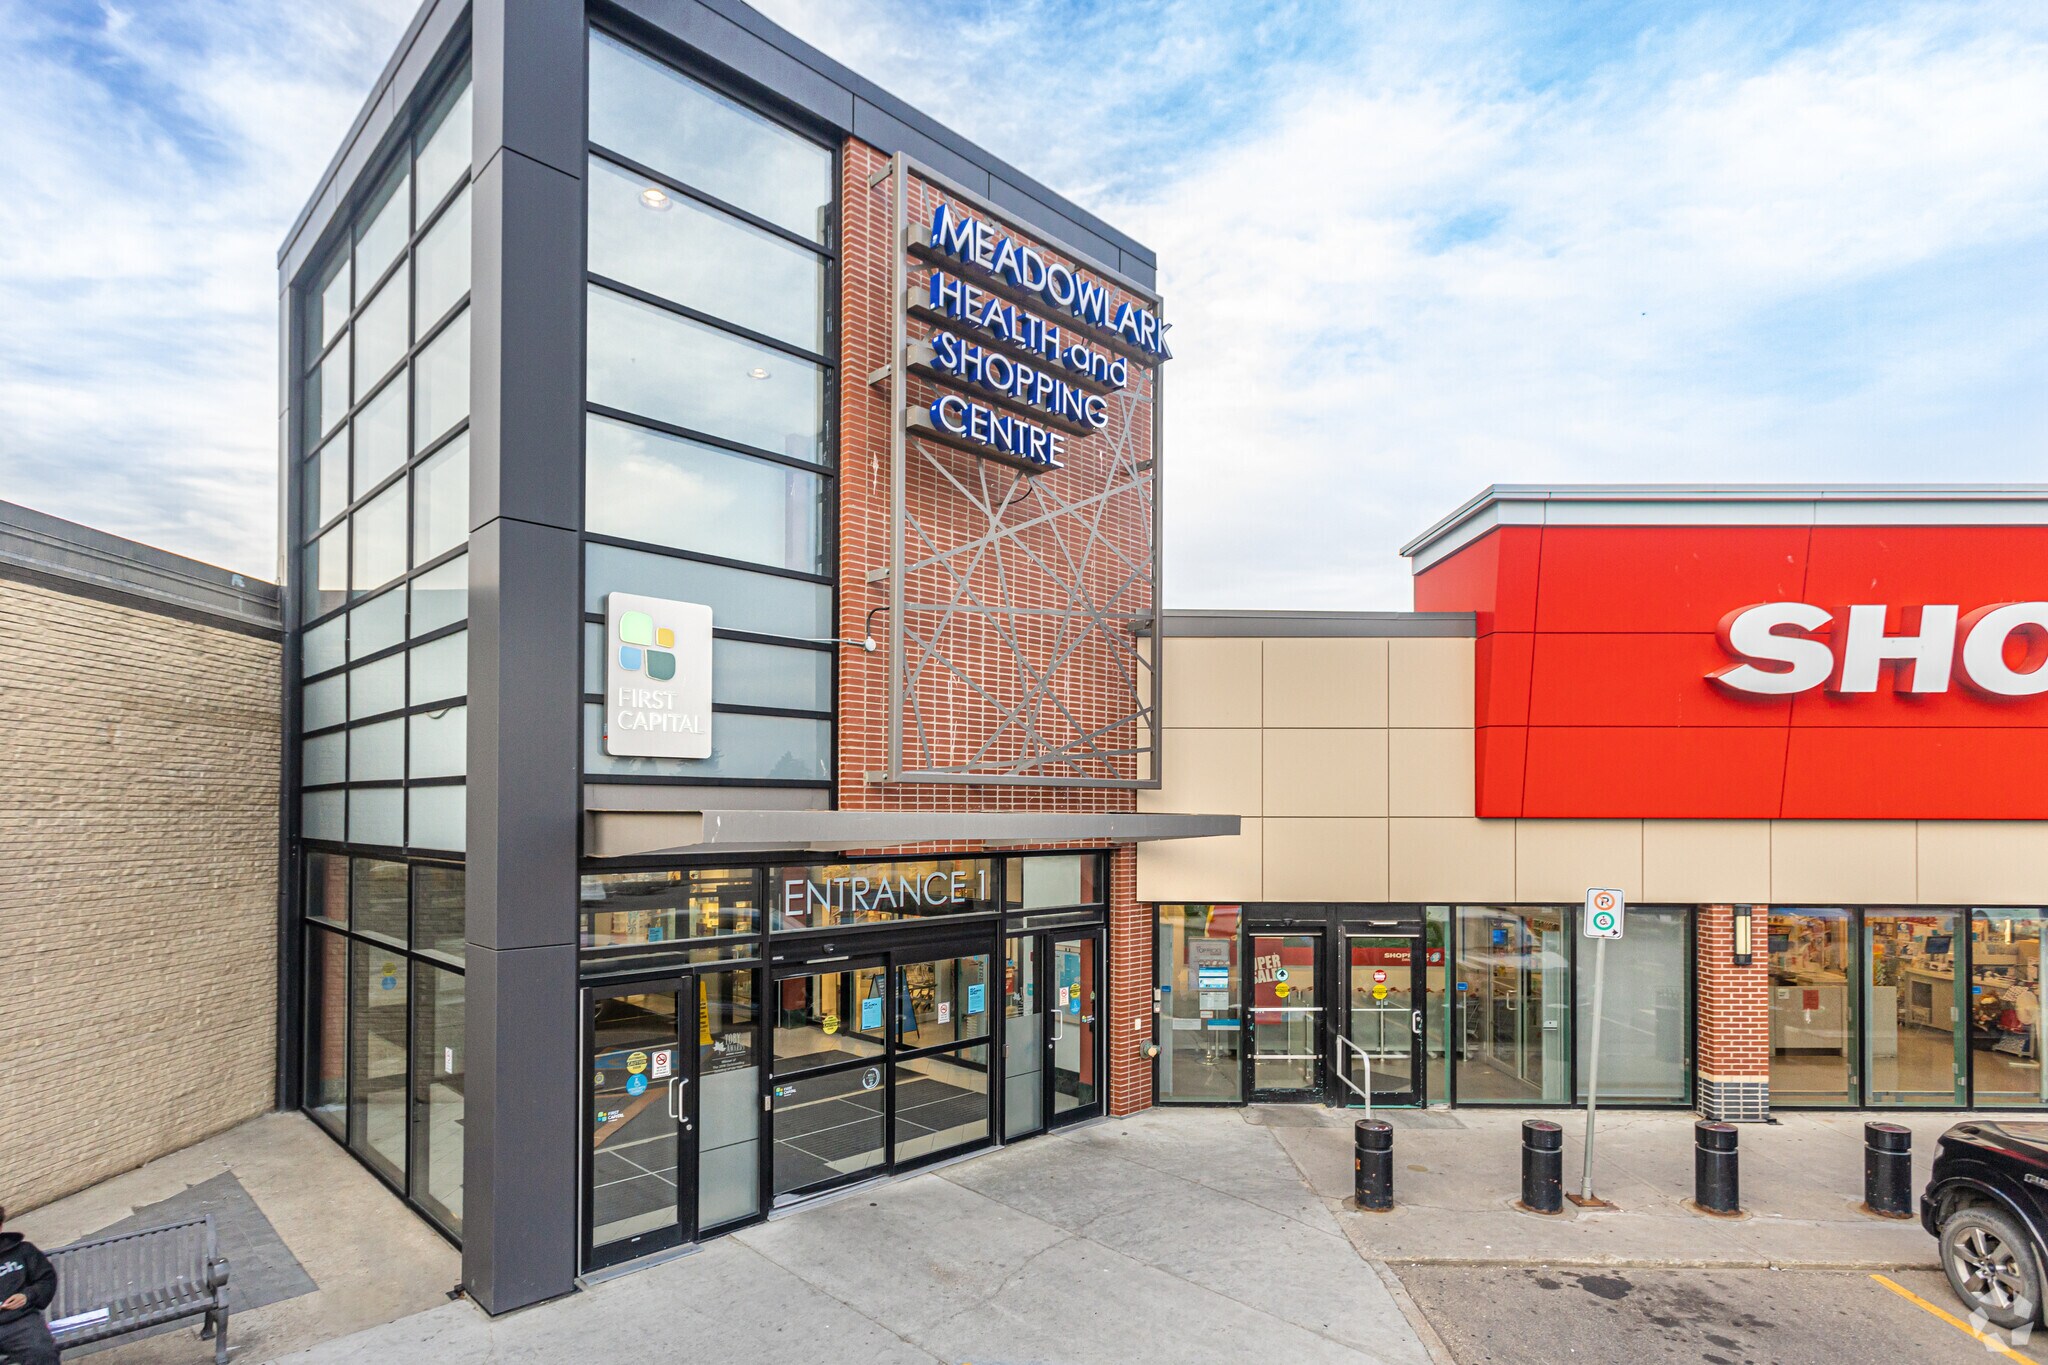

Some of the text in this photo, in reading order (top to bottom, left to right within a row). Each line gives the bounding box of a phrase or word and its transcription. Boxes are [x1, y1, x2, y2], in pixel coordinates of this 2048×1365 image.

[931, 203, 1172, 359] MEADOWLARK
[930, 271, 1128, 388] HEALTH and
[930, 332, 1108, 428] SHOPPING
[930, 395, 1065, 467] CENTRE
[1704, 602, 2048, 695] SHO
[617, 710, 705, 734] CAPITAL
[618, 687, 678, 710] FIRST
[785, 870, 985, 916] ENTRANCE 1
